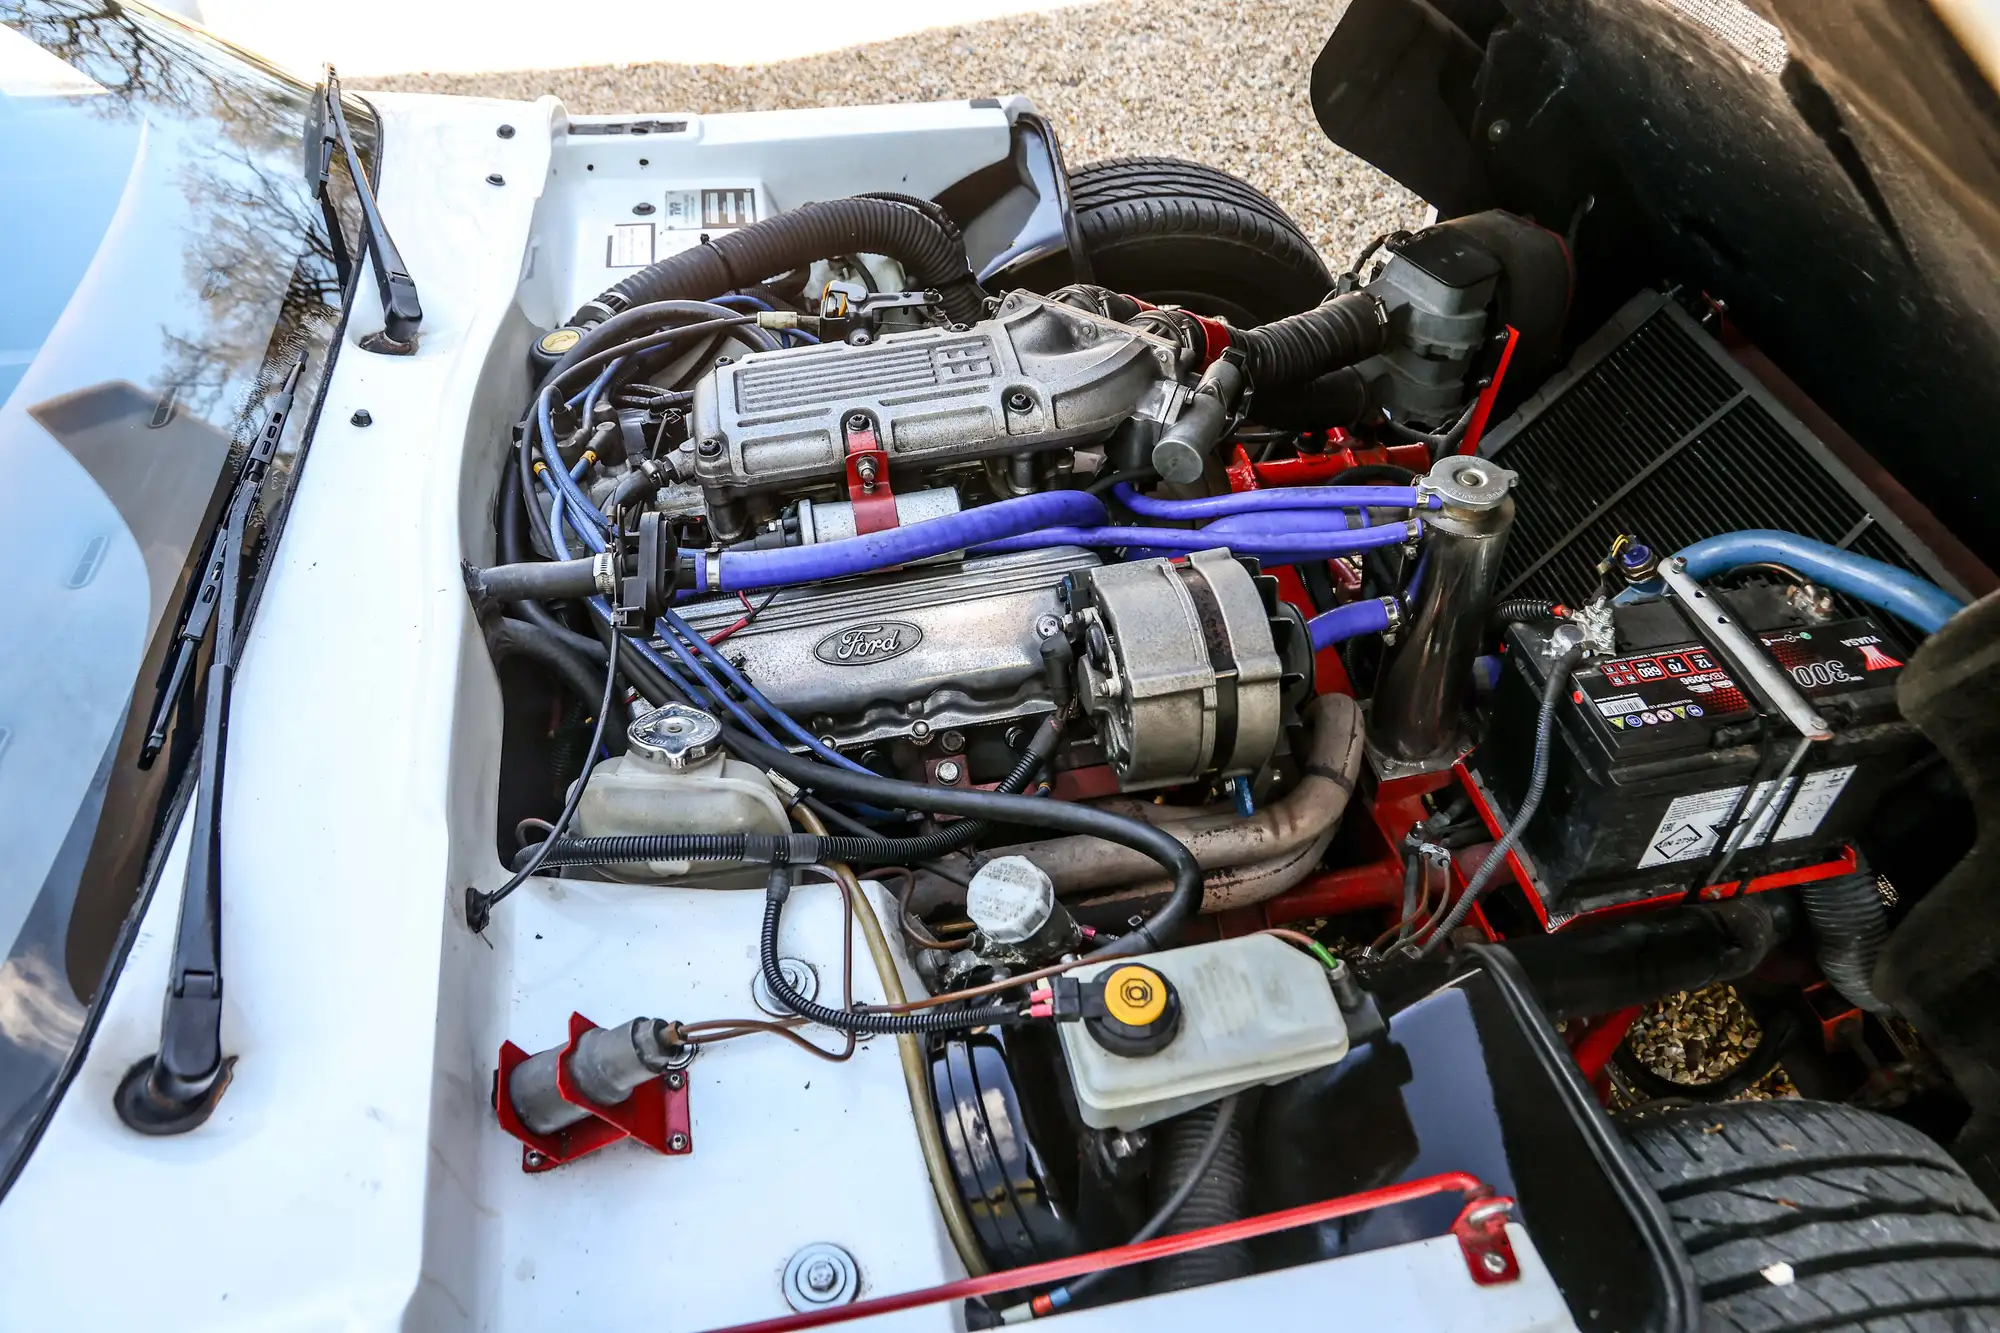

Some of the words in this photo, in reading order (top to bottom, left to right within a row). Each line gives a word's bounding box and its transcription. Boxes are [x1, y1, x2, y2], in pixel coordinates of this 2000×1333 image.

[837, 625, 900, 660] Ford
[1840, 635, 1882, 647] YUASA
[1668, 662, 1687, 673] 76
[1694, 658, 1713, 669] 12
[1637, 666, 1662, 678] 680
[1679, 671, 1729, 685] YBX3096
